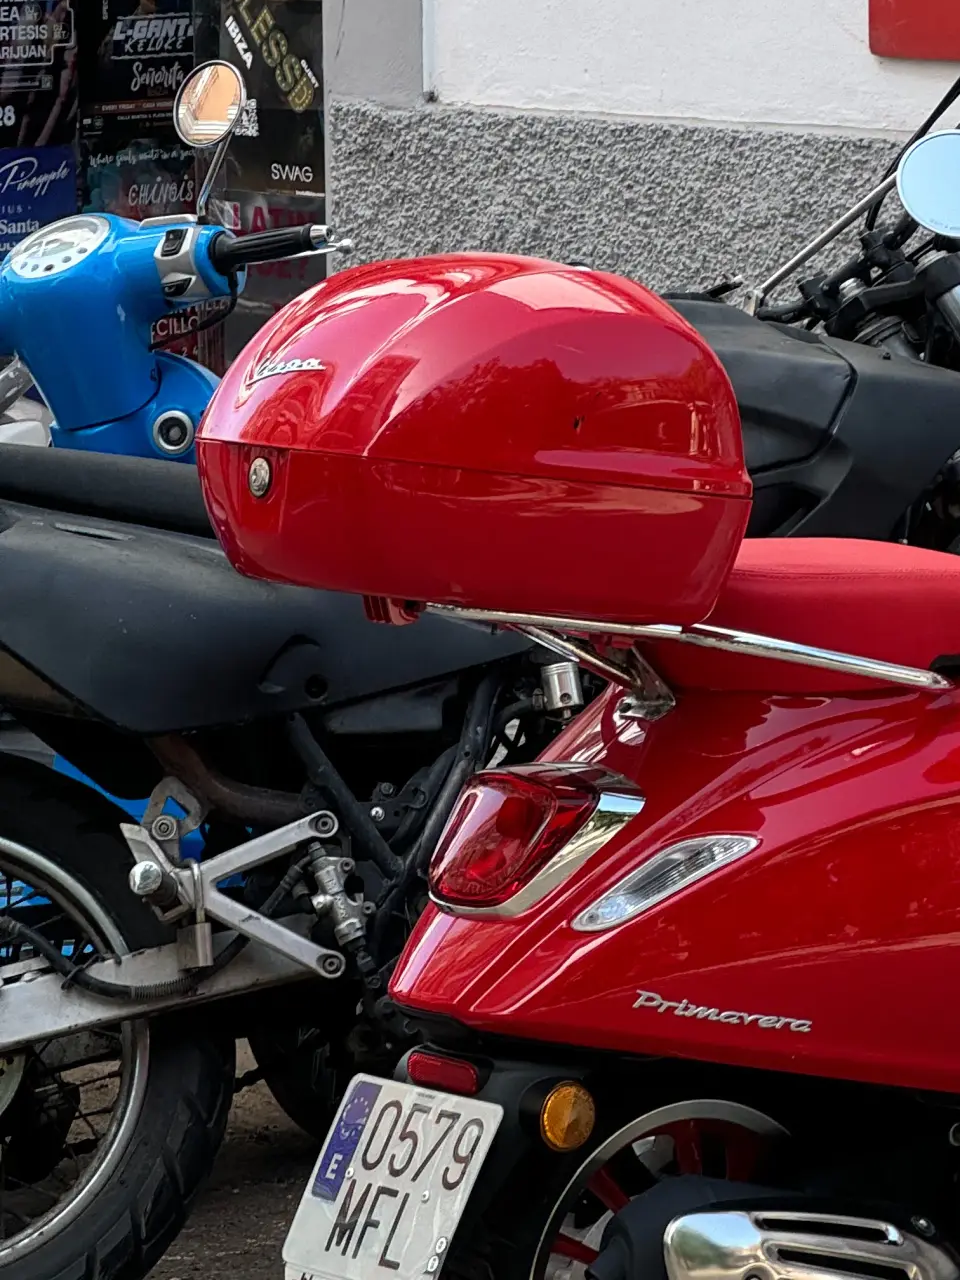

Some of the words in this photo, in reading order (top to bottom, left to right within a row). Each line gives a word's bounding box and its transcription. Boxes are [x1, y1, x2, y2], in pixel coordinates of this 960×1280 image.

[225, 15, 253, 70] IBIZA
[271, 163, 313, 183] SWAG
[245, 351, 326, 387] Vespa
[632, 989, 812, 1033] Primavera
[325, 1152, 344, 1180] E
[361, 1099, 485, 1191] 0579
[324, 1178, 411, 1271] MFL
